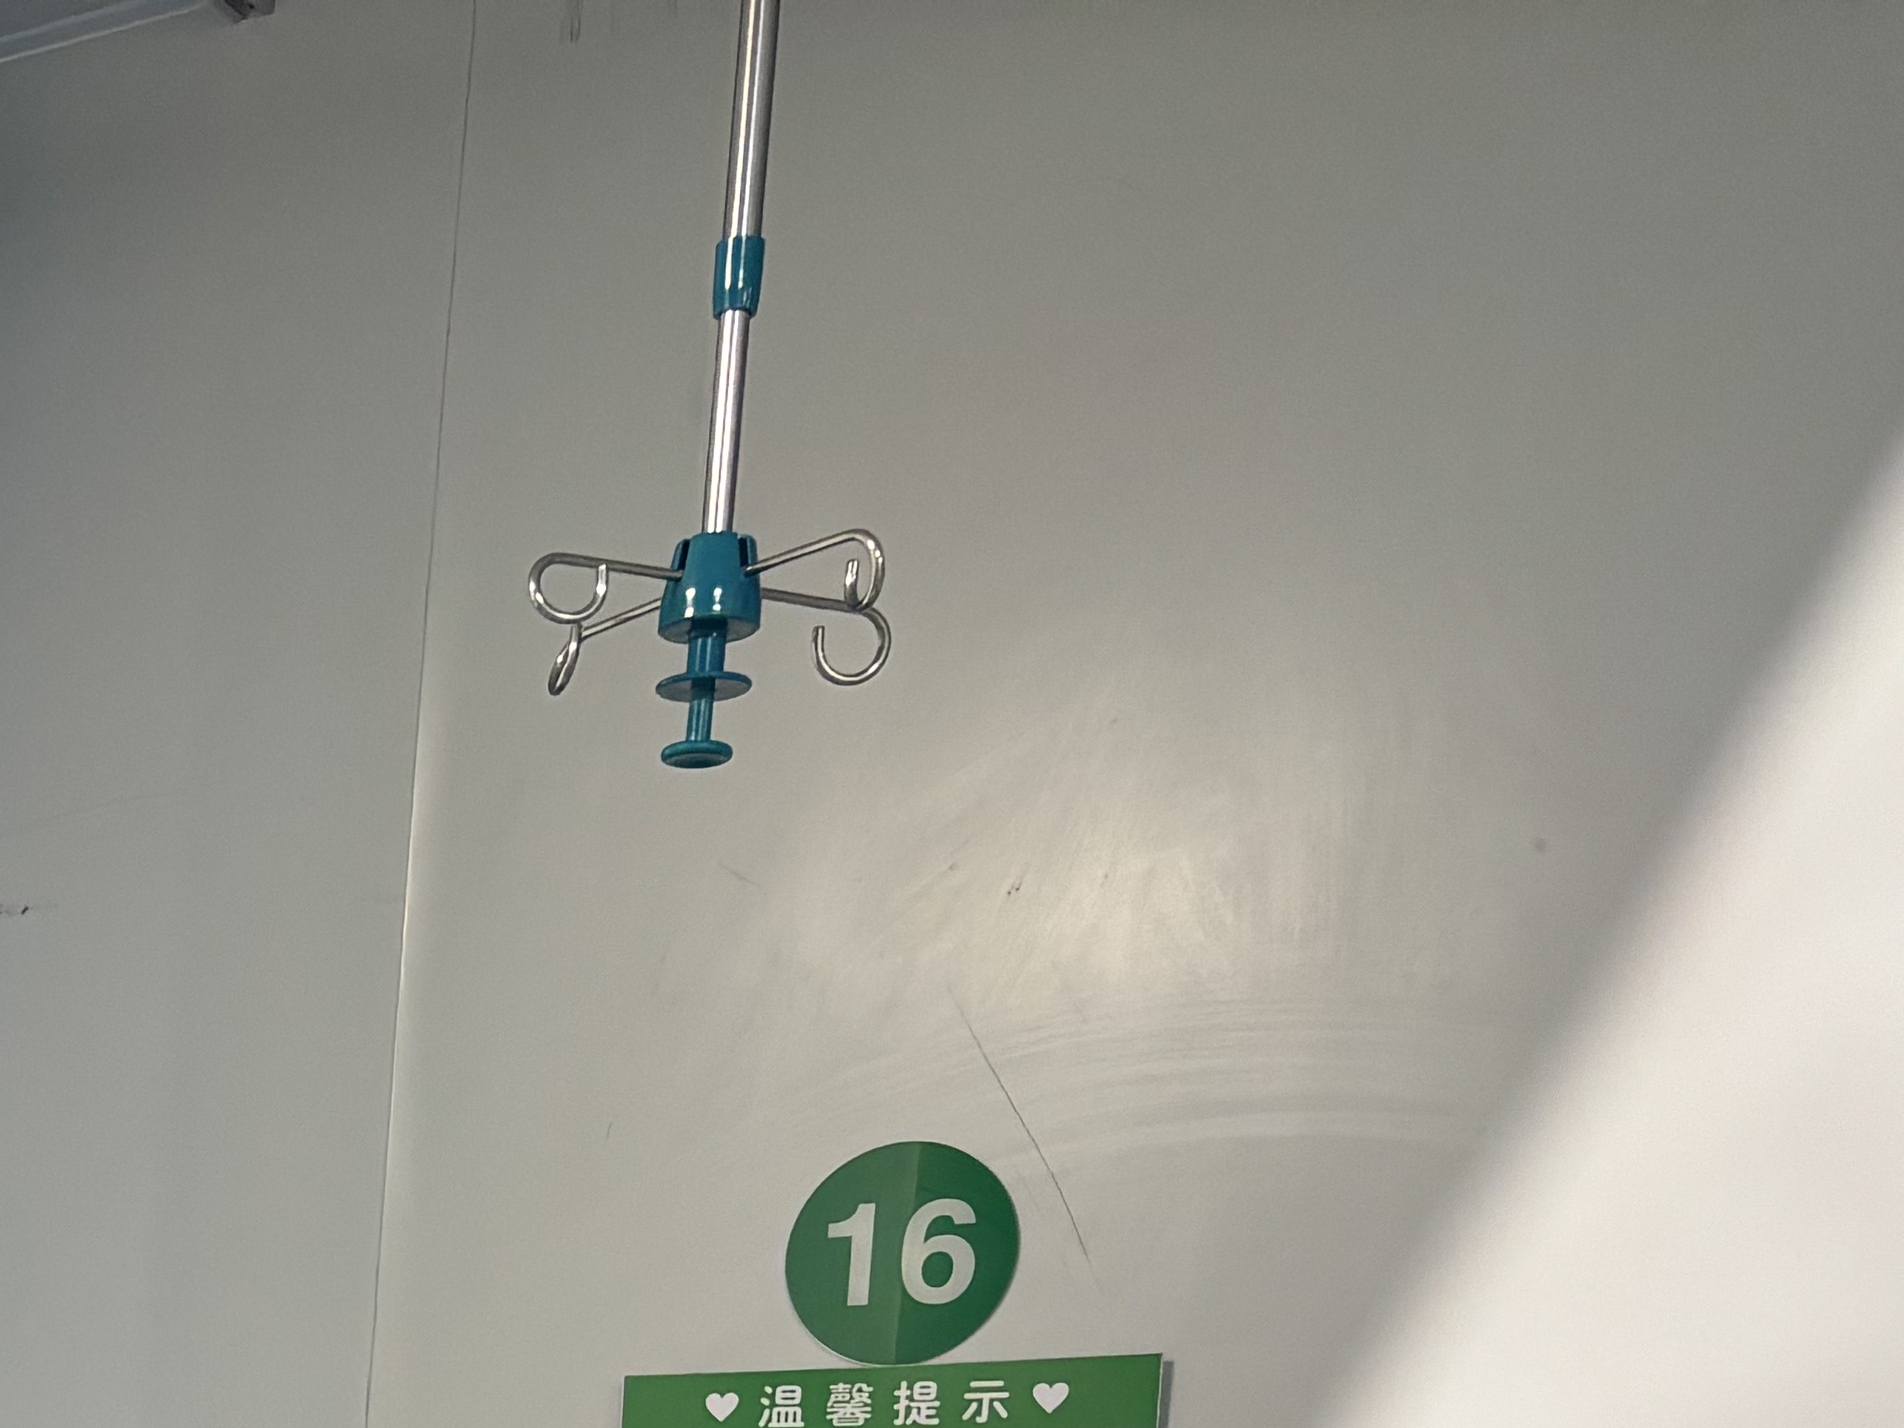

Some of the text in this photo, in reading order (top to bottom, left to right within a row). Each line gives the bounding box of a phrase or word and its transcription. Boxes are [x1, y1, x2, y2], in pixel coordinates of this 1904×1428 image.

[827, 1198, 978, 1306] 16
[758, 1380, 1011, 1428] 温馨提示
